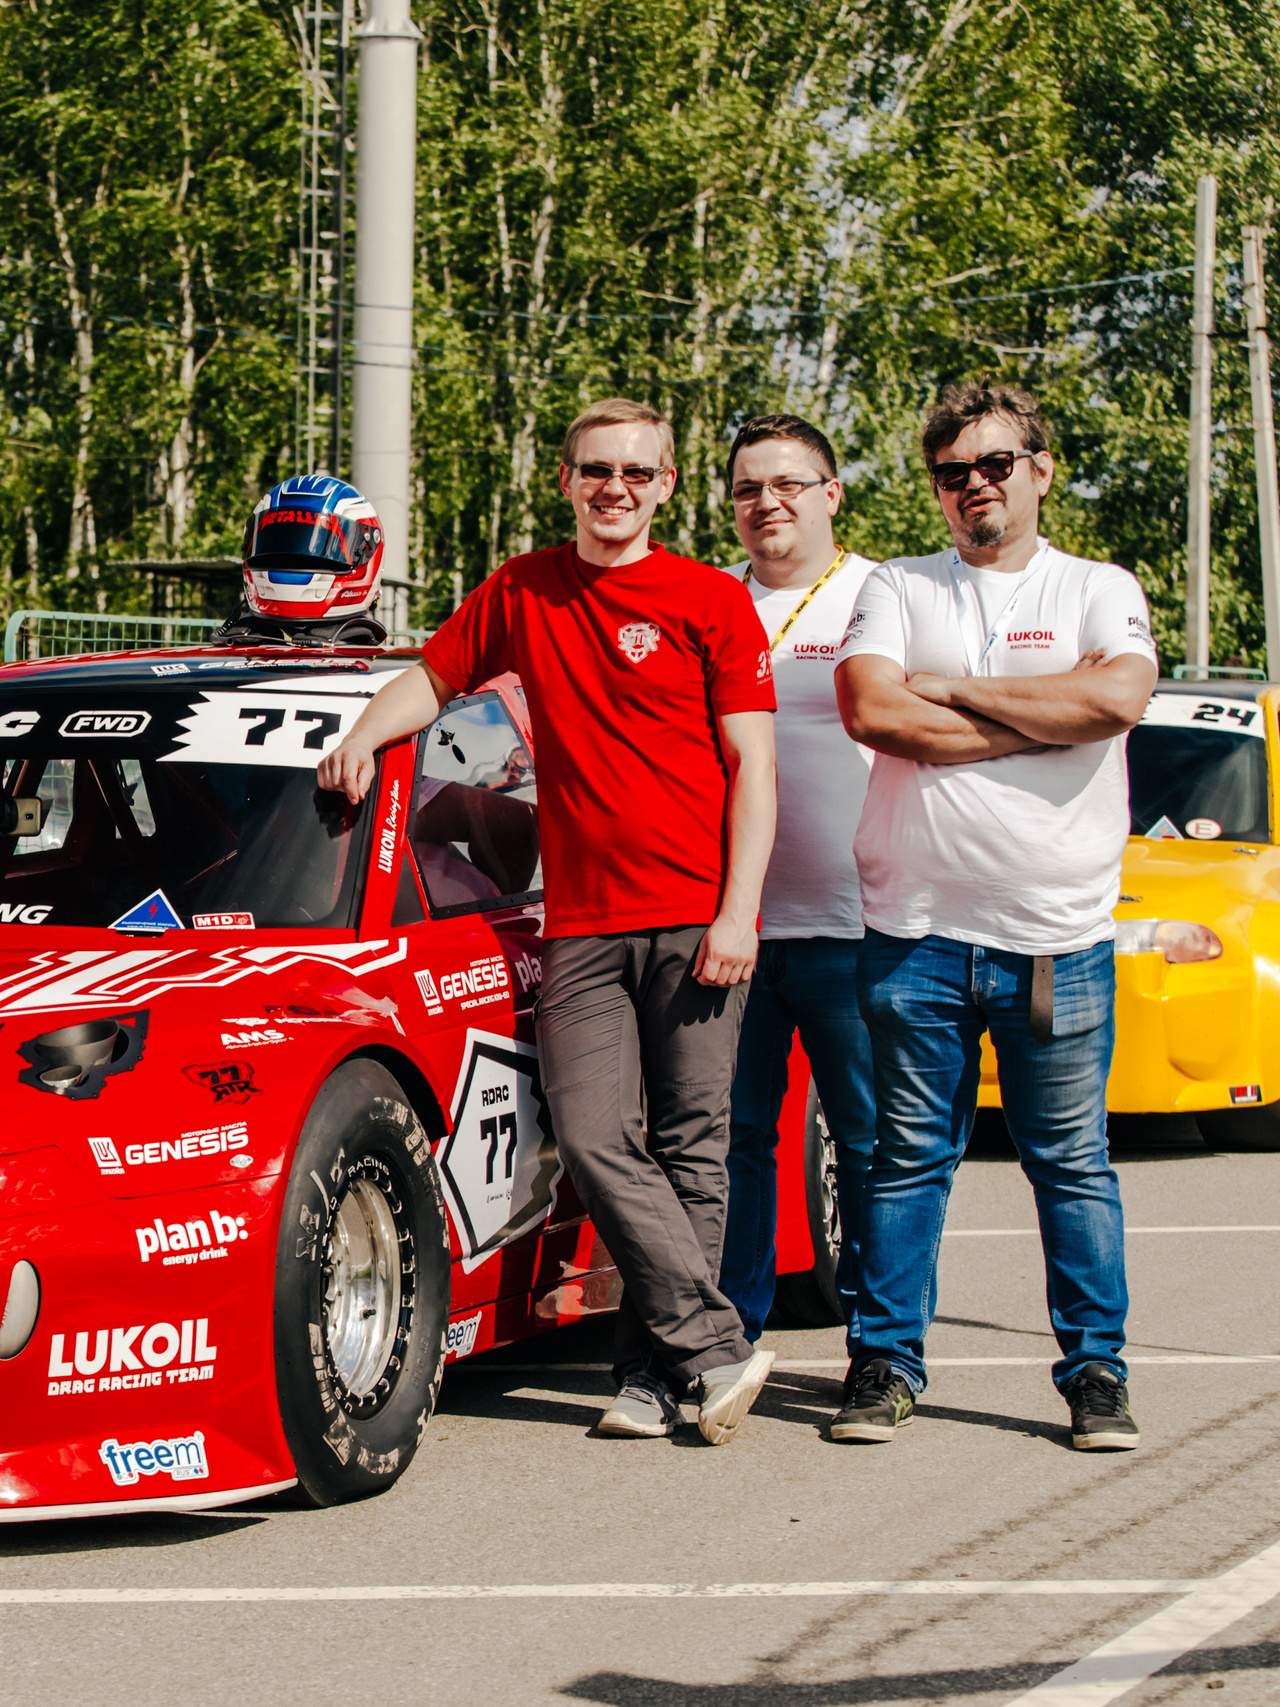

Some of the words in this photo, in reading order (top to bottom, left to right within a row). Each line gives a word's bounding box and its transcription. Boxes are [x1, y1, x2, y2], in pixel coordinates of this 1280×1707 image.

[1007, 631, 1055, 642] LUKOIL
[73, 716, 138, 731] FWD
[1191, 702, 1257, 727] 24
[238, 708, 342, 750] 77
[1195, 822, 1213, 836] E
[378, 828, 396, 874] LUKOIL
[197, 916, 234, 927] M1D
[440, 962, 508, 1001] GENESIS
[515, 952, 542, 993] pla
[221, 1029, 285, 1046] AMS
[199, 1066, 240, 1085] 77
[481, 1084, 509, 1107] RDRC
[125, 1127, 248, 1165] GENESIS
[480, 1111, 517, 1185] 77
[347, 1157, 390, 1178] RACING
[135, 1218, 212, 1262] plan
[209, 1210, 248, 1244] b:
[162, 1252, 198, 1266] energy
[199, 1246, 228, 1260] drink
[48, 1318, 217, 1377] LUKOIL
[447, 1321, 477, 1349] eem
[47, 1379, 95, 1396] DRAG
[99, 1371, 162, 1392] RACING
[166, 1365, 214, 1384] TEAM
[106, 1442, 201, 1475] freem
